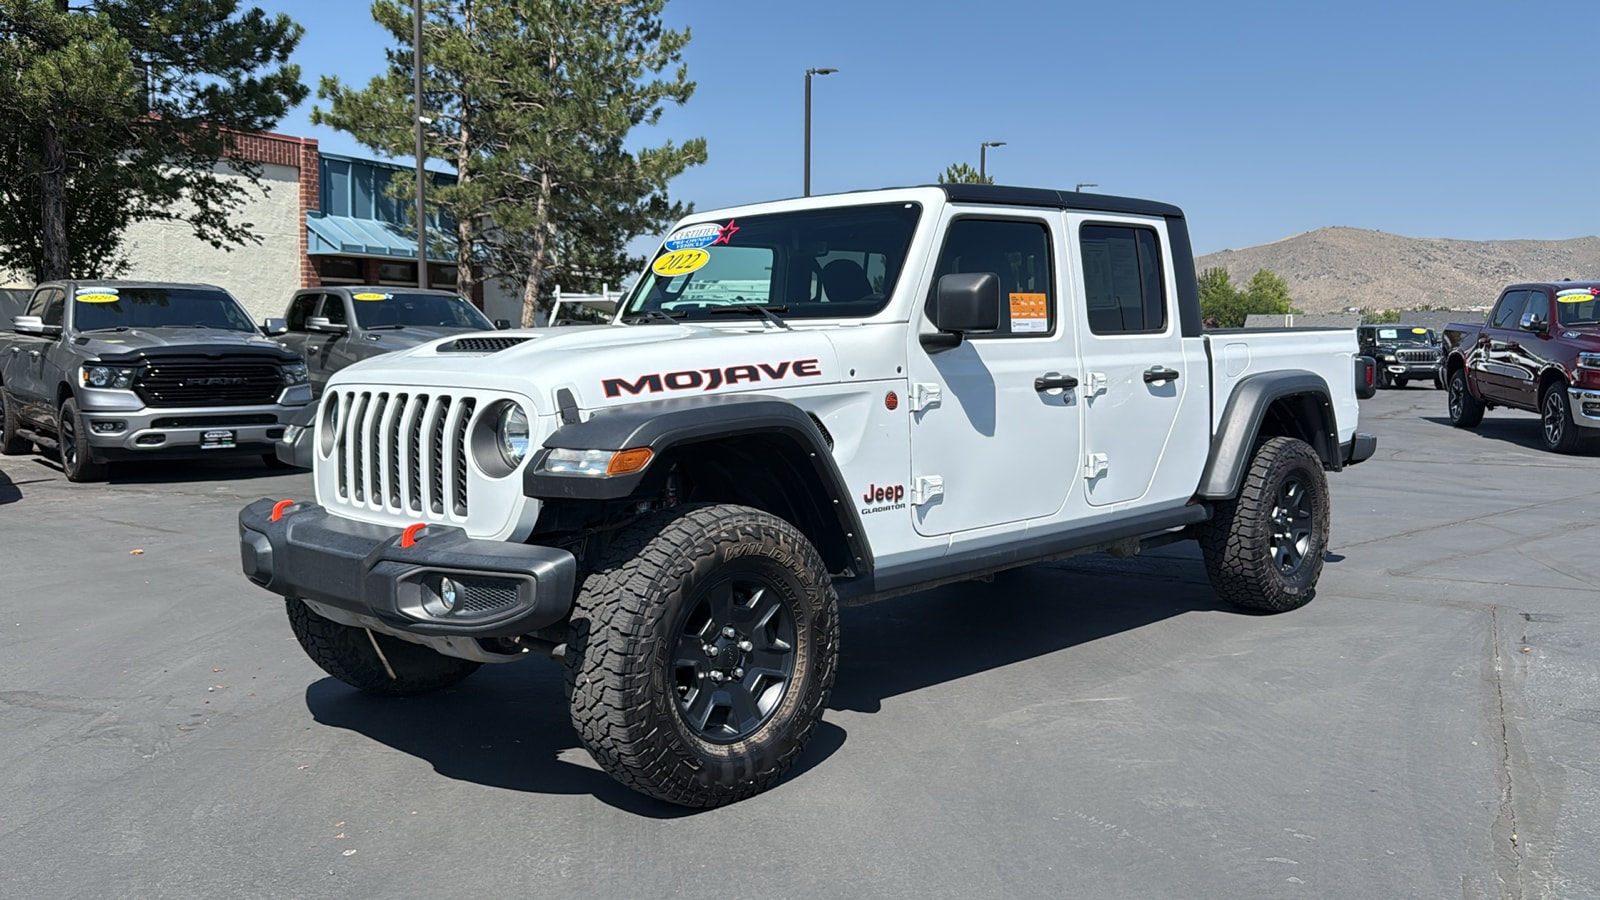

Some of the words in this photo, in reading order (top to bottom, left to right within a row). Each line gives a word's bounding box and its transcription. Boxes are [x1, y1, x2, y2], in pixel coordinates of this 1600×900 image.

[658, 253, 702, 271] 2022
[601, 359, 822, 398] MOJAVE
[863, 483, 904, 505] Jeep
[861, 503, 906, 515] GLADIATOR
